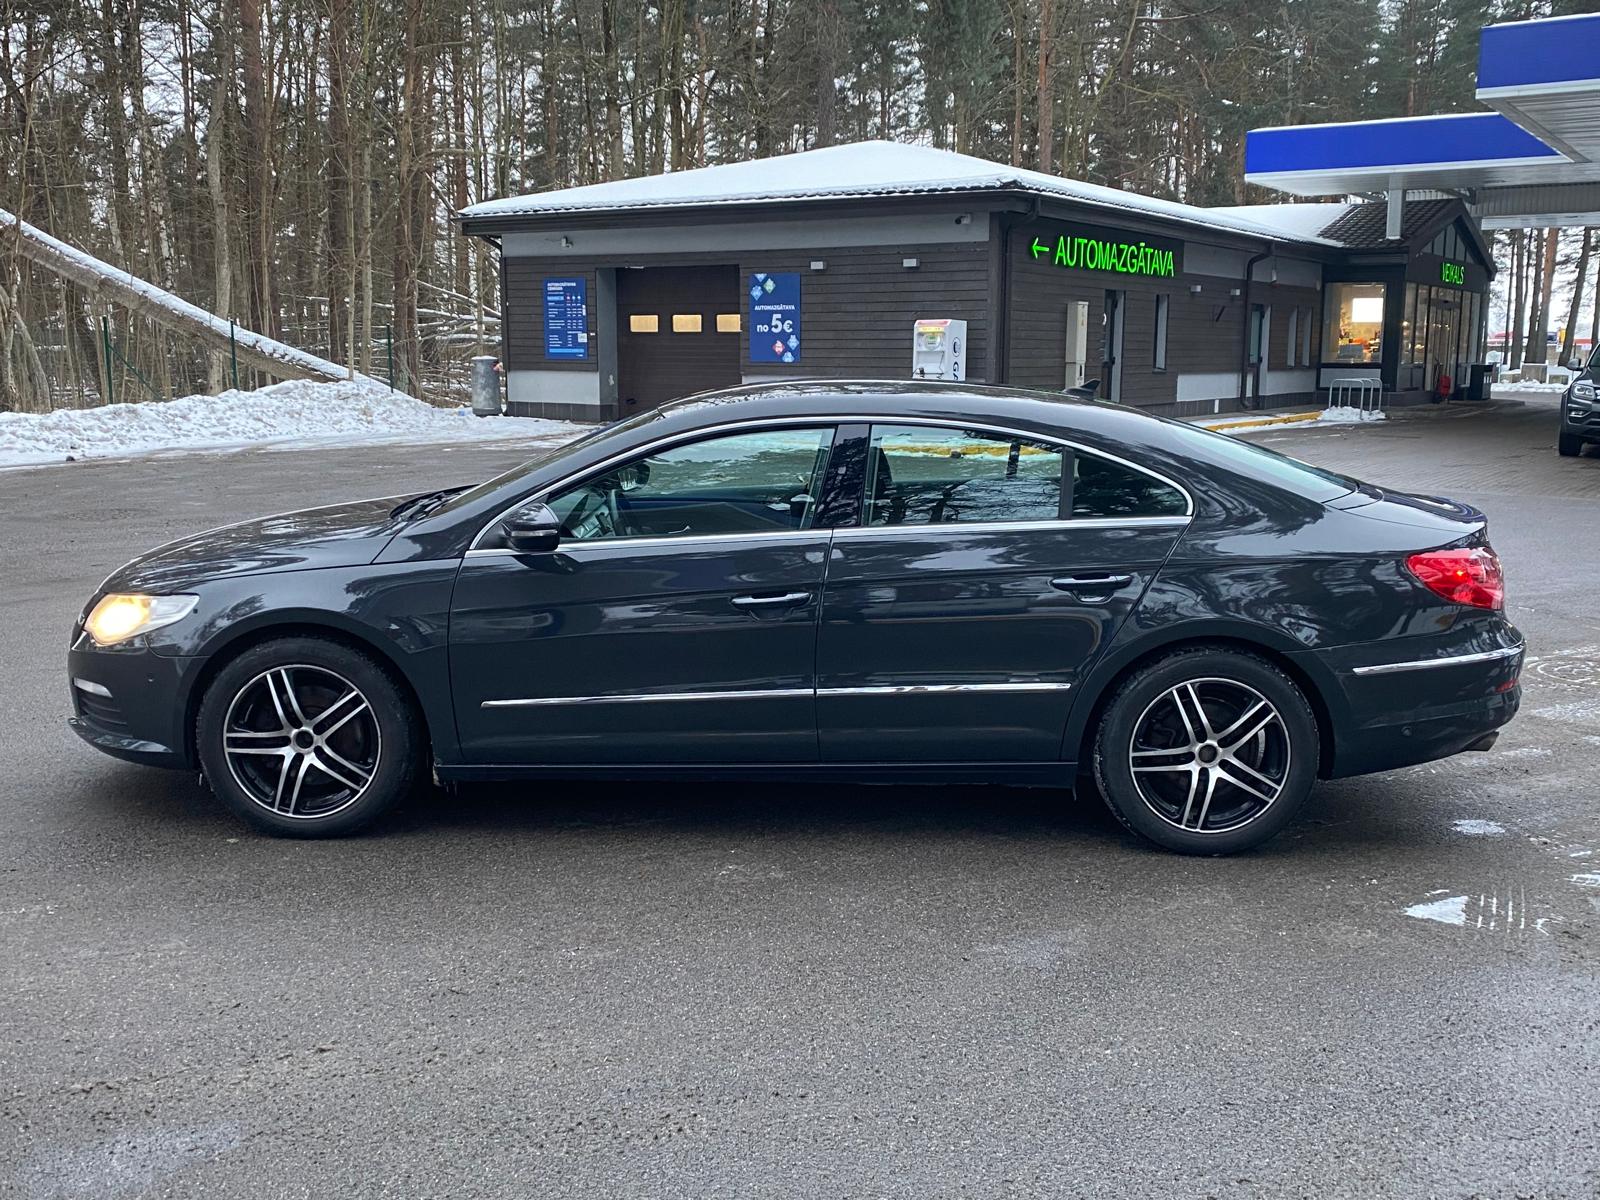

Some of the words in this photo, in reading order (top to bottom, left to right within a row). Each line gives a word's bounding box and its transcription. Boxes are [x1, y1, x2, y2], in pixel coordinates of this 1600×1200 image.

[1055, 235, 1175, 277] AUTOMAZGĀTAVA
[1442, 261, 1465, 285] VEIKALS
[754, 303, 796, 311] AUTOMAZGĀTAVA
[756, 324, 769, 333] no
[771, 313, 793, 334] 5€
